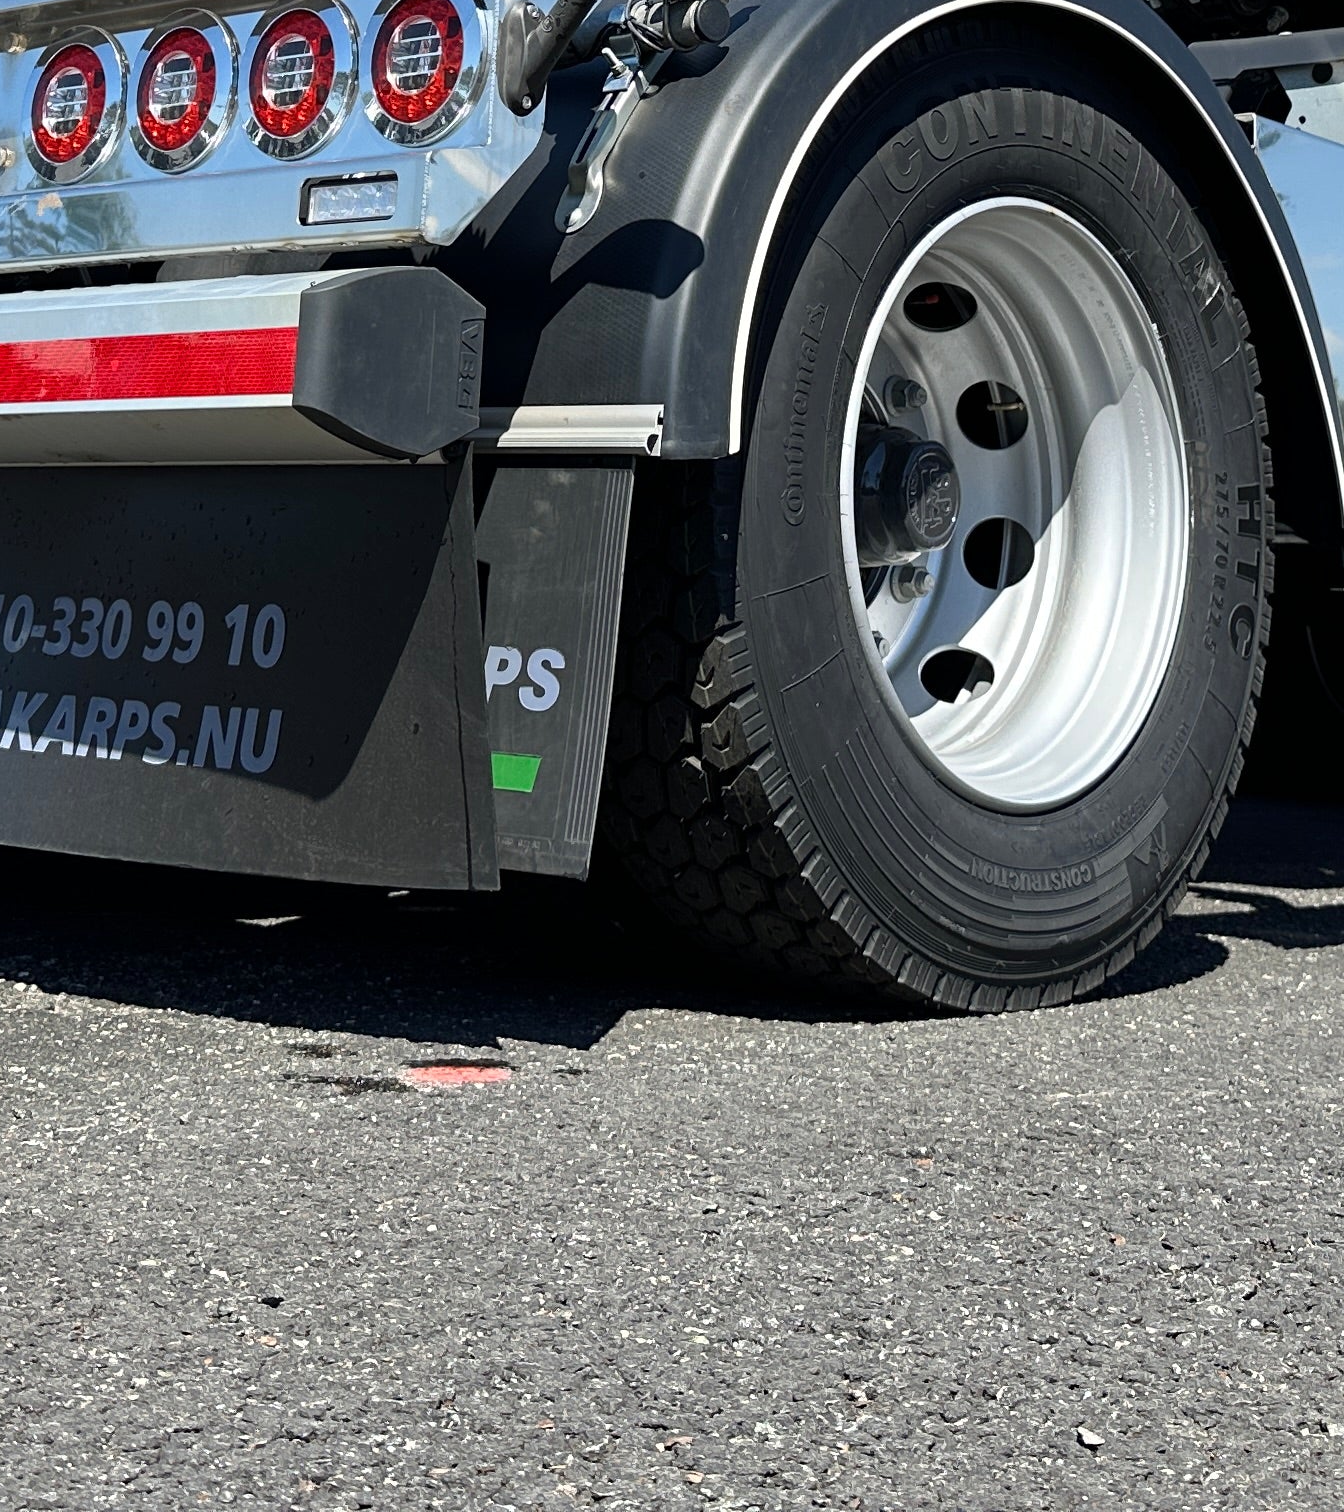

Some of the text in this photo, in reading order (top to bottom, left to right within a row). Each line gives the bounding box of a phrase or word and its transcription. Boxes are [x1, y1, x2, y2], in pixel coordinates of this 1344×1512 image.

[142, 600, 206, 665] 99
[224, 604, 286, 669] 10
[971, 857, 1093, 893] CONSTRUCTION
